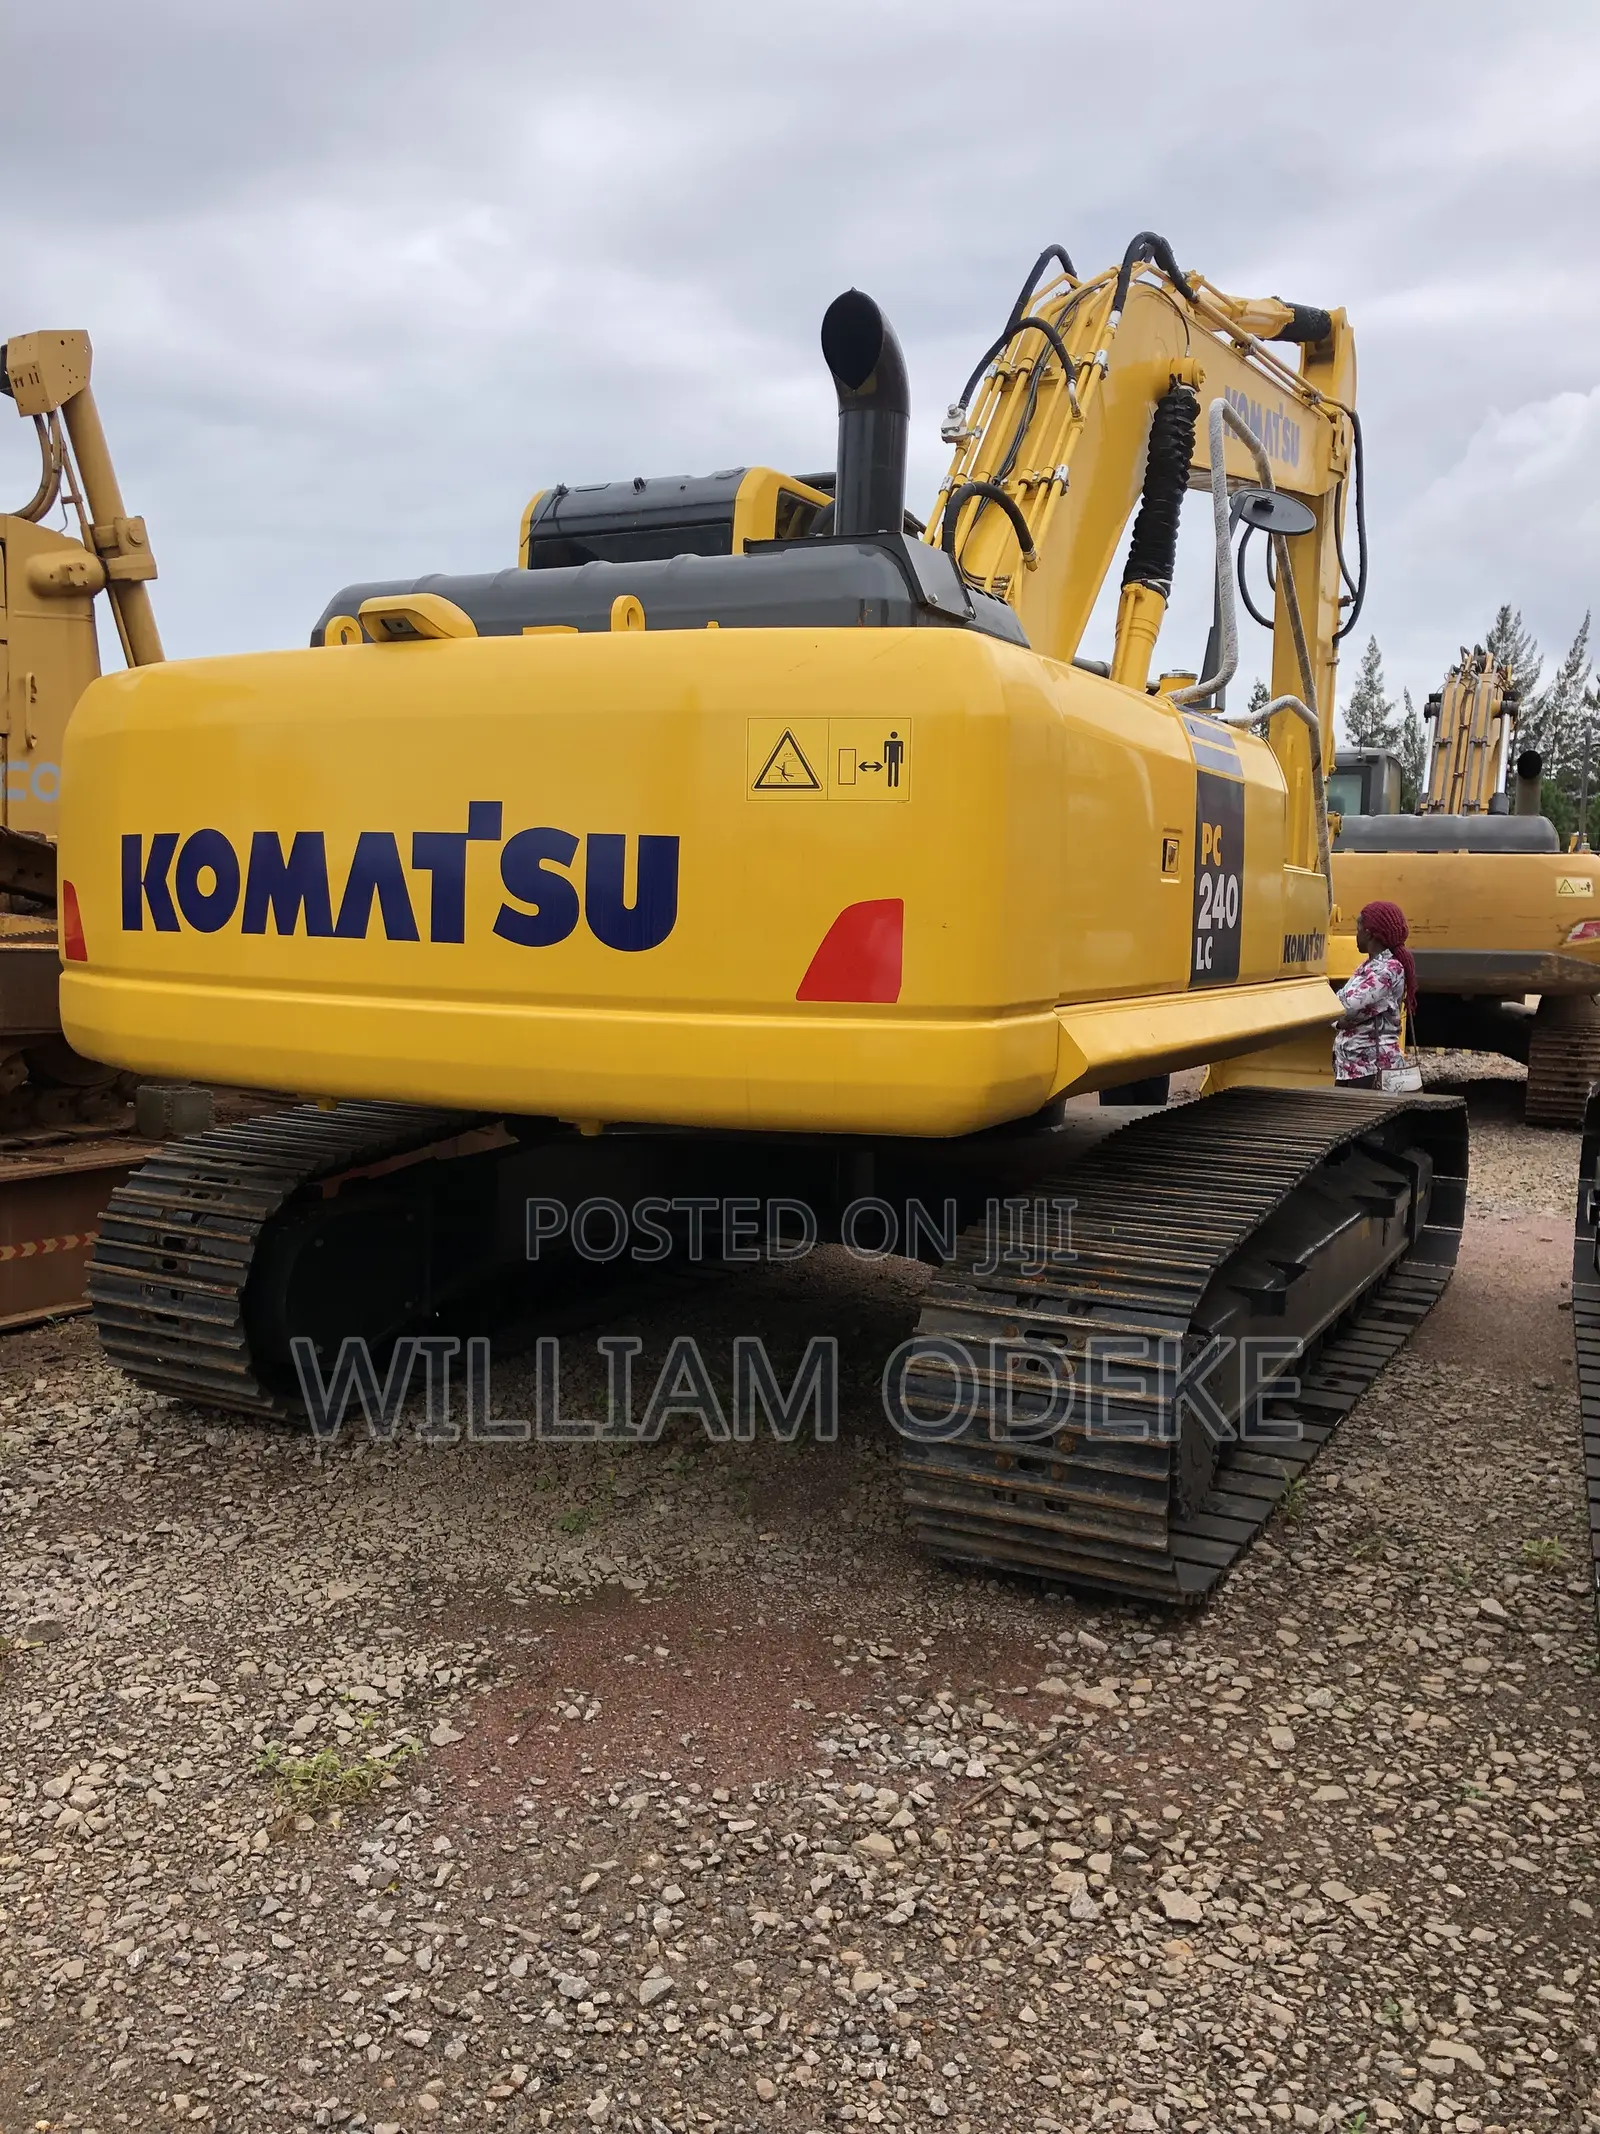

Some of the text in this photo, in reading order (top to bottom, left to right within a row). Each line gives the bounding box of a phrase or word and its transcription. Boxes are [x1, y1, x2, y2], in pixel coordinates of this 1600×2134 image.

[1201, 822, 1222, 867] PC
[121, 800, 680, 952] KOMATSU
[1197, 872, 1239, 930] 240
[1195, 935, 1213, 971] LC
[1283, 927, 1326, 964] KOMATSU
